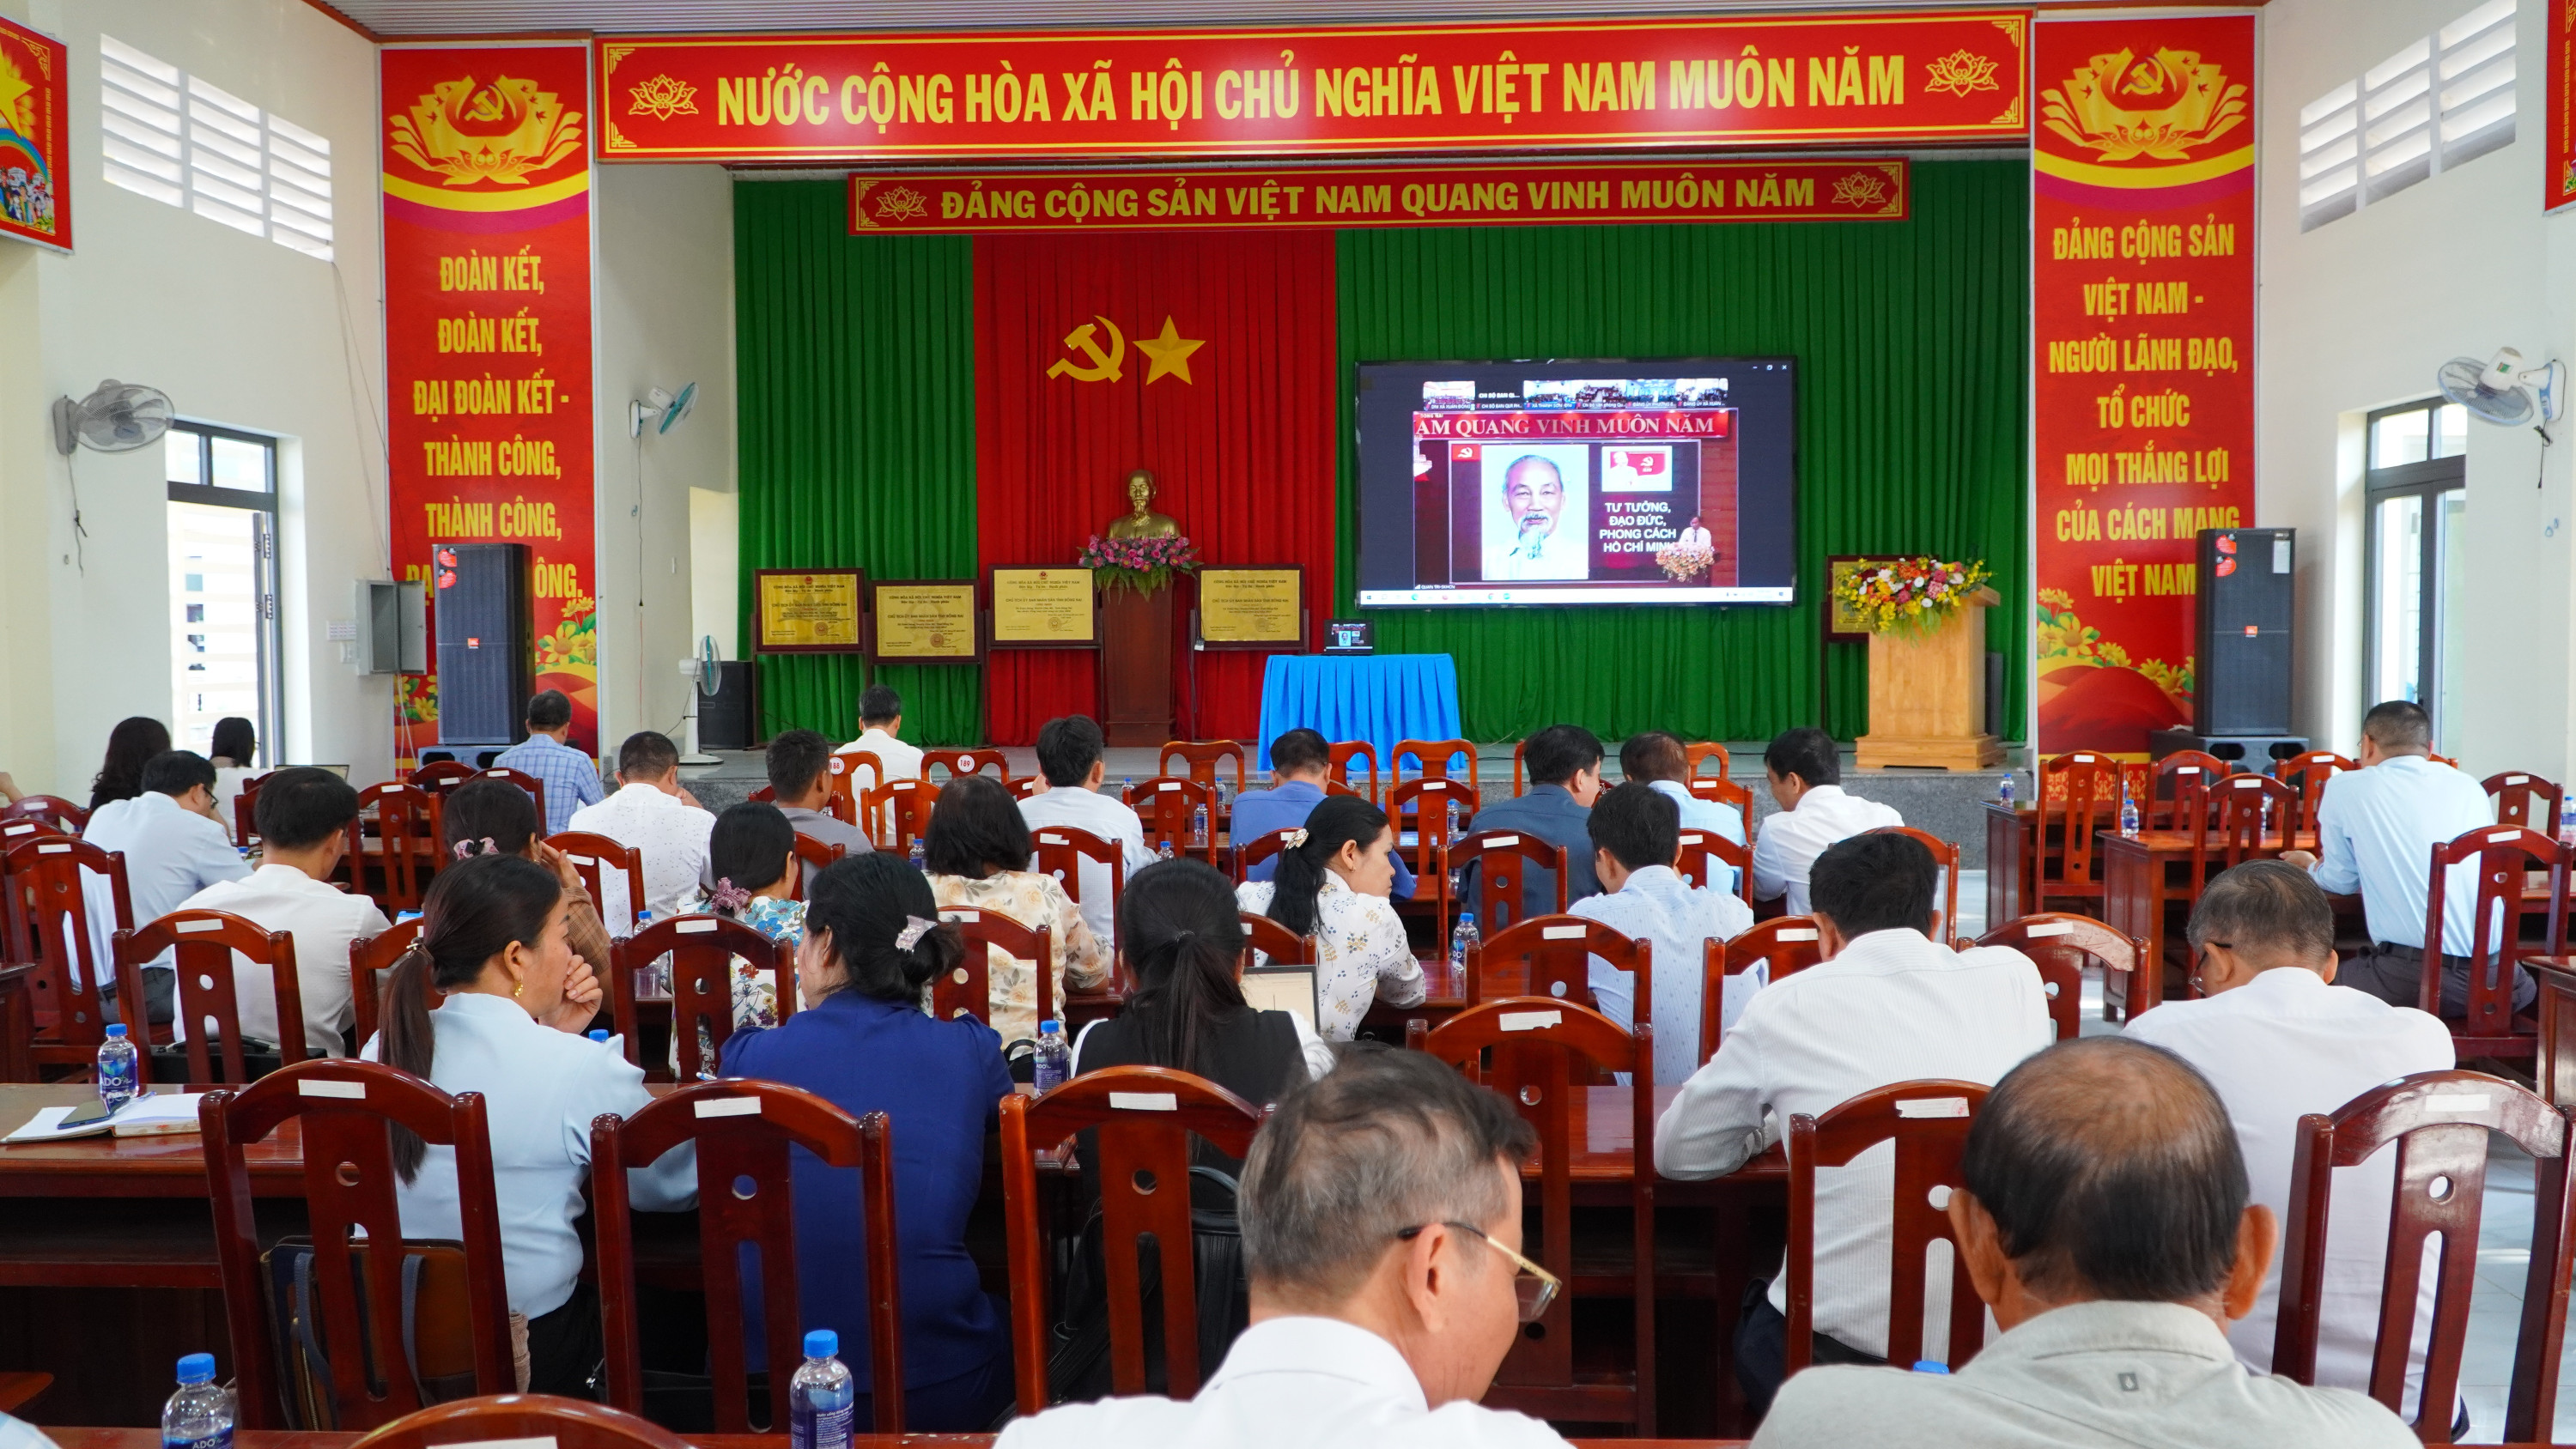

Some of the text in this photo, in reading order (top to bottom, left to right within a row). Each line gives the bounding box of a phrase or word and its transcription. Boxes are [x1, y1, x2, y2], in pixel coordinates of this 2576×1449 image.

[718, 45, 1905, 133] NƯỚC CỘNG HÒA XÃ HỘI CHỦ NGHĨA VIỆT NAM MUÔN NĂM
[941, 173, 1814, 223] ĐẢNG CỘNG SẢN VIỆT NAM QUANG VINH MUÔN NĂM
[2053, 214, 2234, 264] ĐẢNG CỘNG SẢN
[440, 245, 544, 295] ĐOÀN KẾT,
[2084, 276, 2130, 322] VIỆT
[2136, 282, 2188, 315] NAM
[438, 306, 543, 356] ĐOÀN KẾT,
[2049, 332, 2238, 377] NGƯỜI LÃNH ĐẠO,
[413, 380, 448, 422] ĐẠI
[453, 372, 511, 415] ĐOÀN
[517, 368, 555, 415] KẾT
[2097, 384, 2190, 428] TỔ CHỨC
[1455, 419, 1530, 437] QUANG
[1536, 419, 1590, 433] VINH
[1596, 414, 1661, 433] MUÔN
[1666, 414, 1715, 433] NĂM
[424, 433, 561, 479] THÀNH CÔNG,
[2066, 440, 2229, 492] MỌI THẮNG LỢI
[425, 495, 562, 541] THÀNH CÔNG,
[1605, 502, 1622, 512] TƯ
[1609, 513, 1666, 527] ĐẠO ĐỨC,
[2057, 499, 2101, 543] CỦA
[2107, 502, 2166, 541] CÁCH
[1599, 526, 1676, 539] PHONG CÁCH
[1623, 540, 1643, 552] CHÍ
[1646, 542, 1670, 552] MIN
[533, 555, 584, 598] ÔNG.
[2092, 558, 2137, 603] VIỆT
[2144, 563, 2196, 596] NAM
